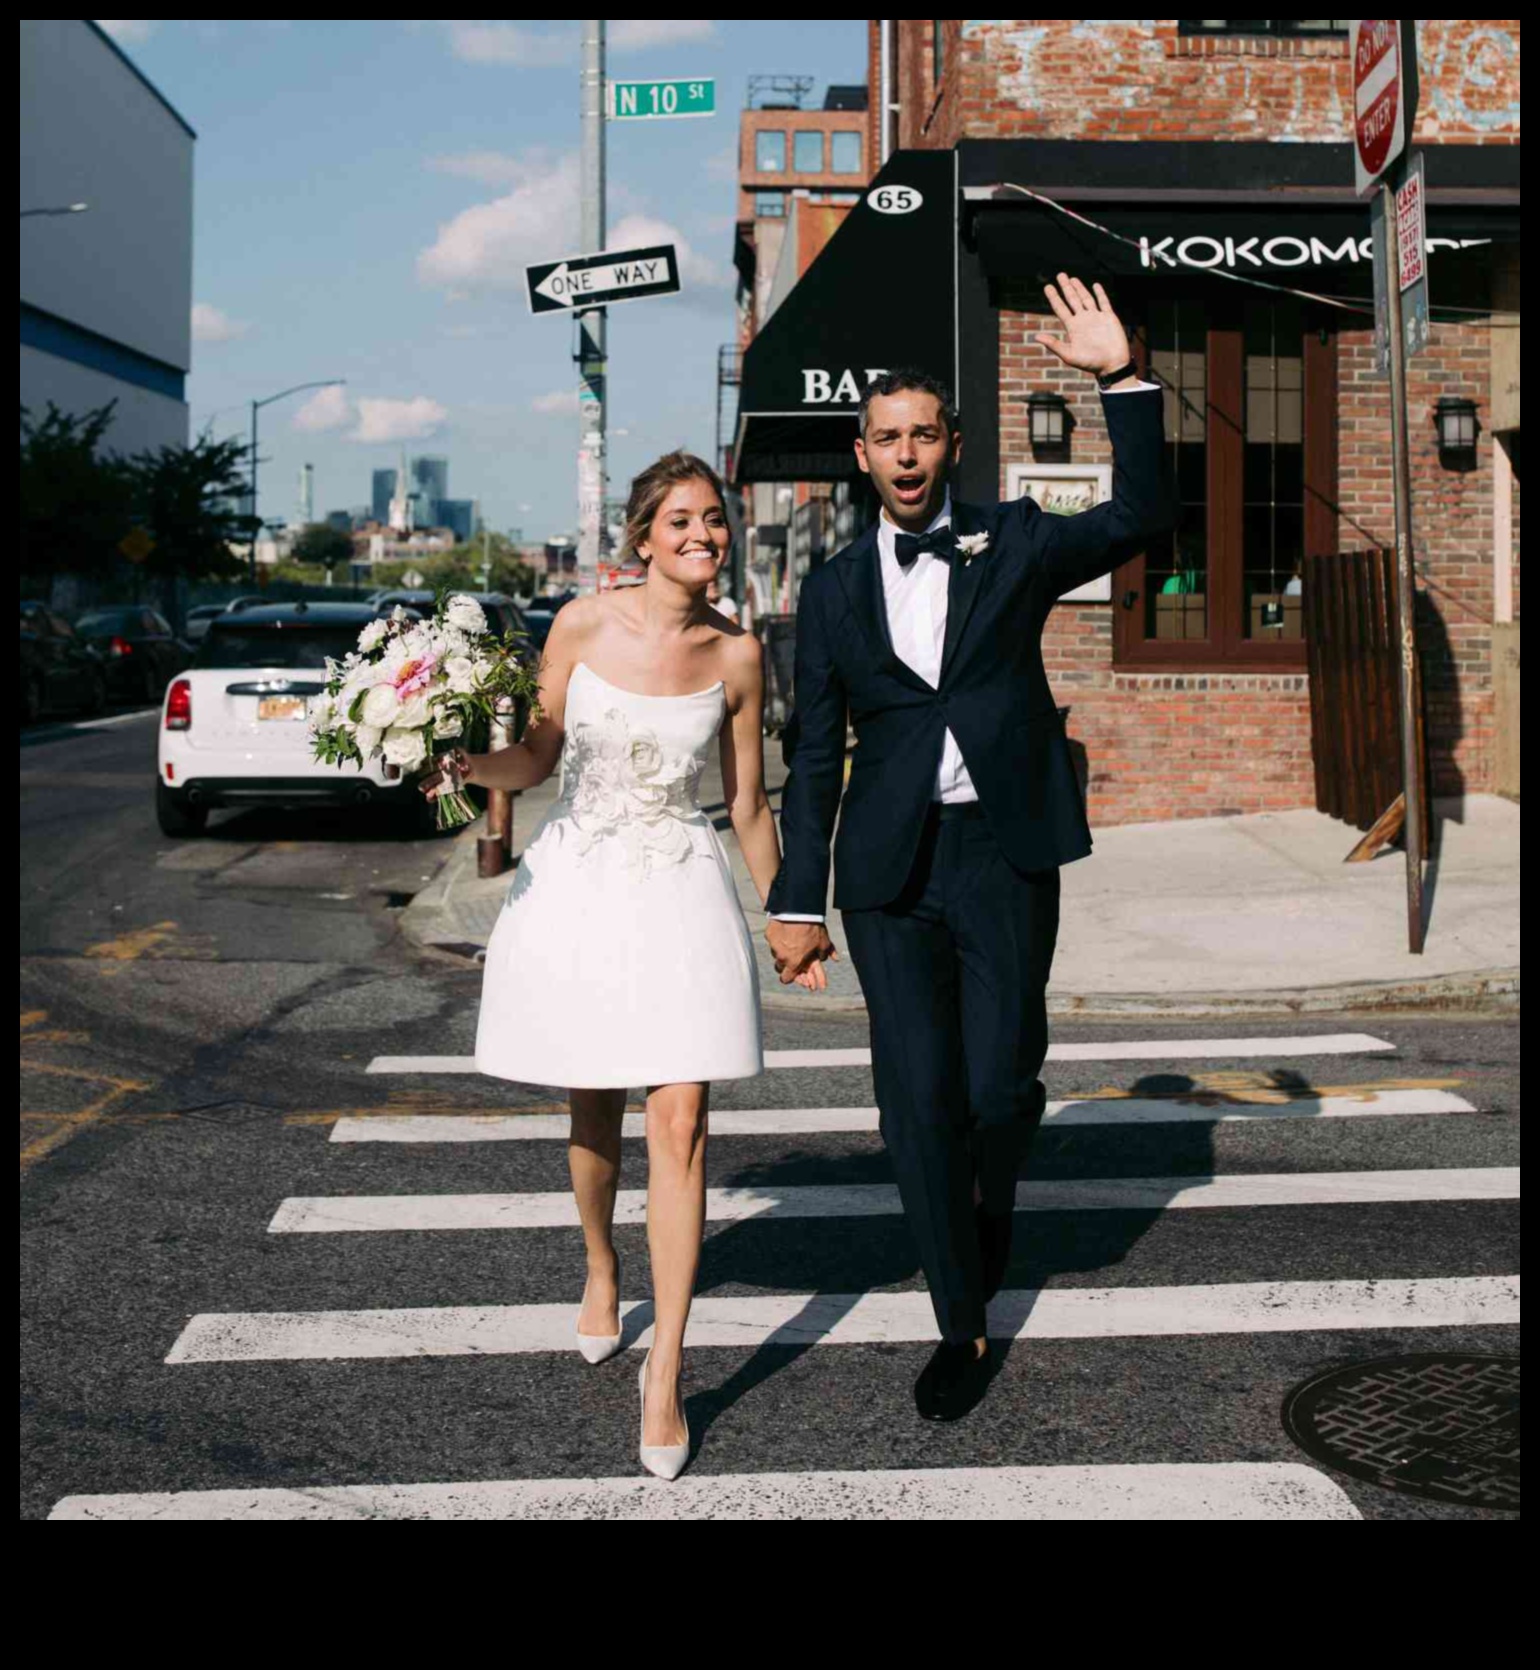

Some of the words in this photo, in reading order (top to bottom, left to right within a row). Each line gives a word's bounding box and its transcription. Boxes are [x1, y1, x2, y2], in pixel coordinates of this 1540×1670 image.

[1358, 38, 1371, 71] DO
[620, 87, 637, 114] N
[649, 85, 678, 113] 10
[688, 84, 705, 99] St
[1363, 96, 1391, 149] ENTER
[876, 190, 912, 210] 65
[1397, 178, 1419, 211] CASH
[551, 271, 594, 295] ONE
[613, 261, 659, 285] WAY
